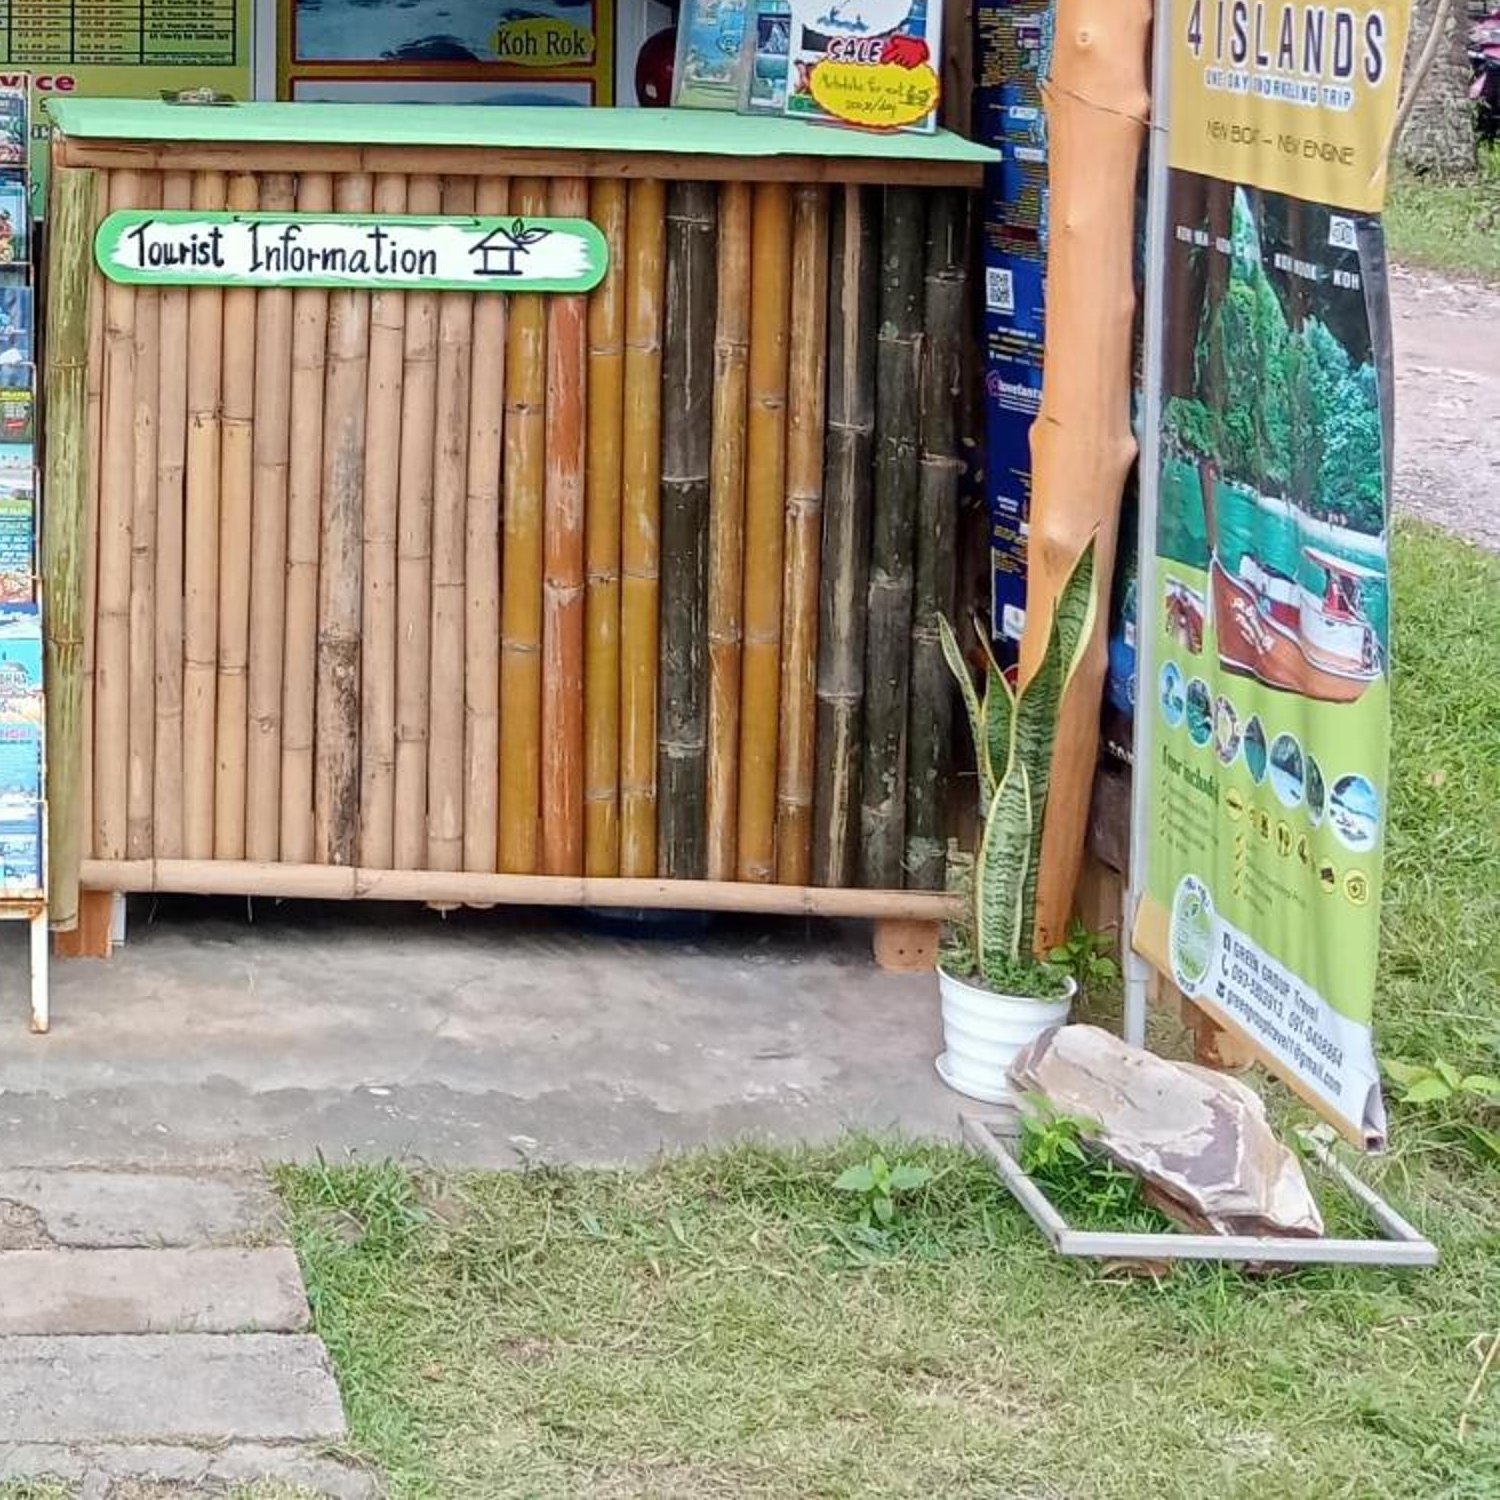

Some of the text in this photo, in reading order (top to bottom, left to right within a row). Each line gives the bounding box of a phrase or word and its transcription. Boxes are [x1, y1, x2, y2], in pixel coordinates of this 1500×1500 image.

[498, 31, 586, 56] Koh Rok
[828, 37, 883, 62] SALE
[1216, 0, 1385, 85] ISLANDS
[128, 218, 437, 277] Tourist Information
